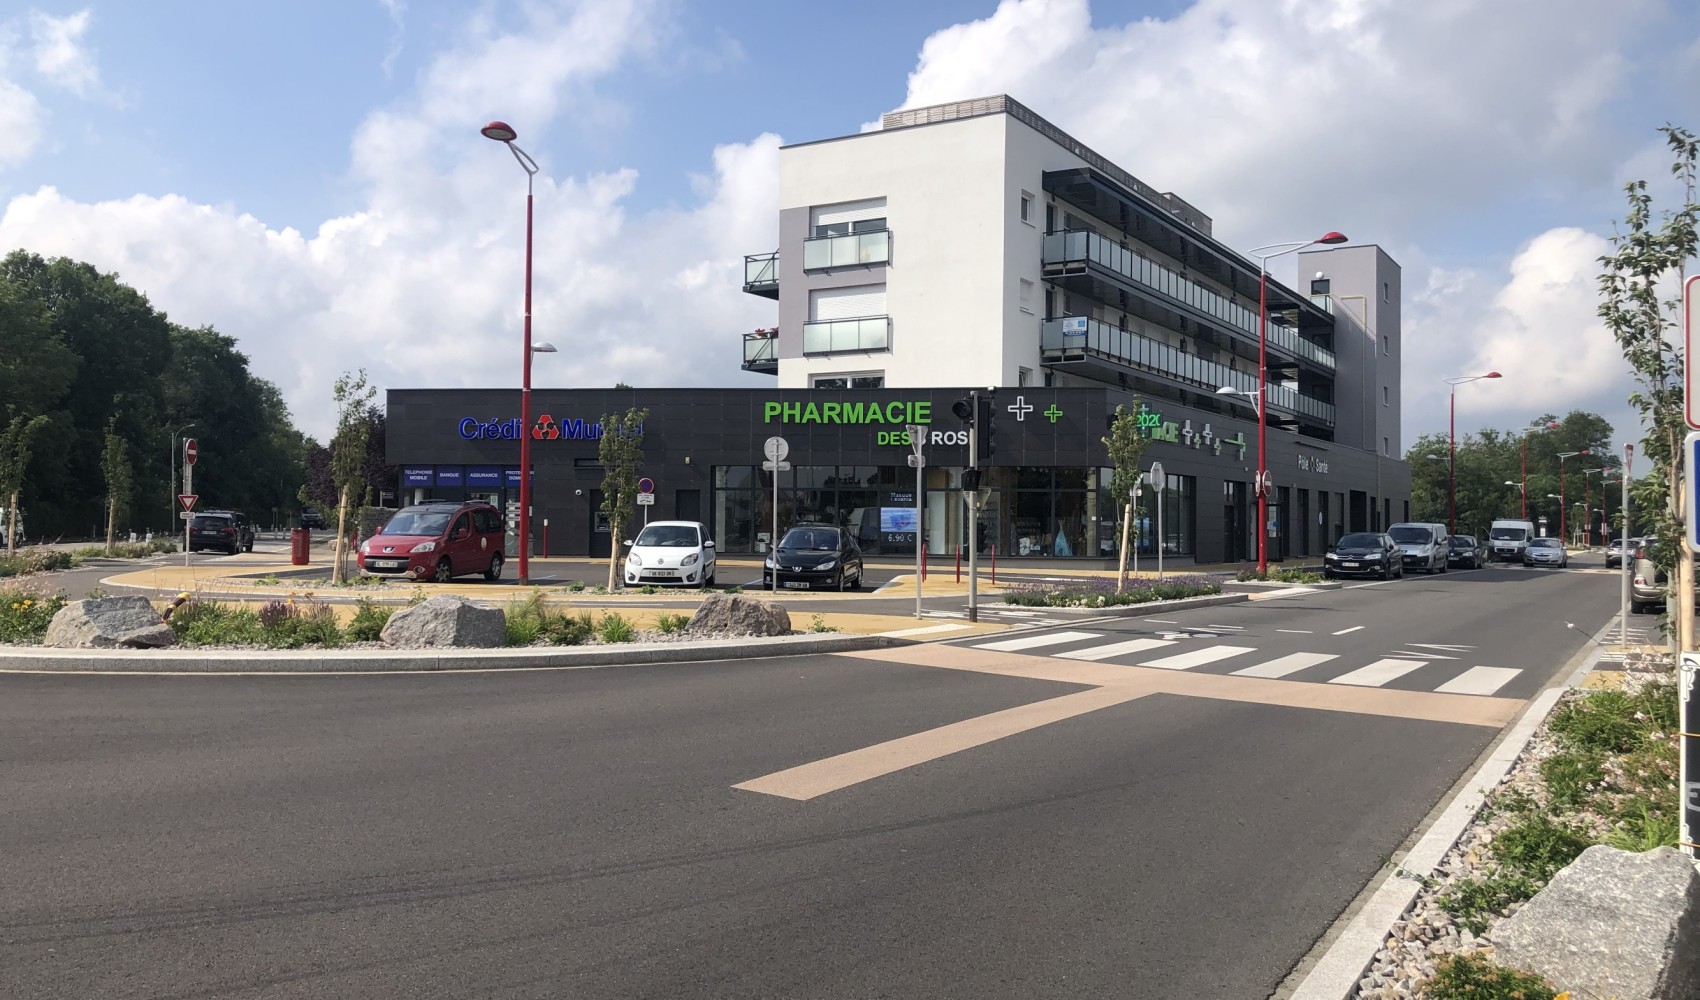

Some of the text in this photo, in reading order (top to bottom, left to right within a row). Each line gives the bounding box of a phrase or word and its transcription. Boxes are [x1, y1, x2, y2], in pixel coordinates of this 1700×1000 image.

[764, 401, 932, 424] PHARMACIE
[458, 417, 530, 440] Crédi
[877, 431, 912, 446] DES
[931, 431, 970, 446] ROS
[1315, 458, 1329, 474] Santé
